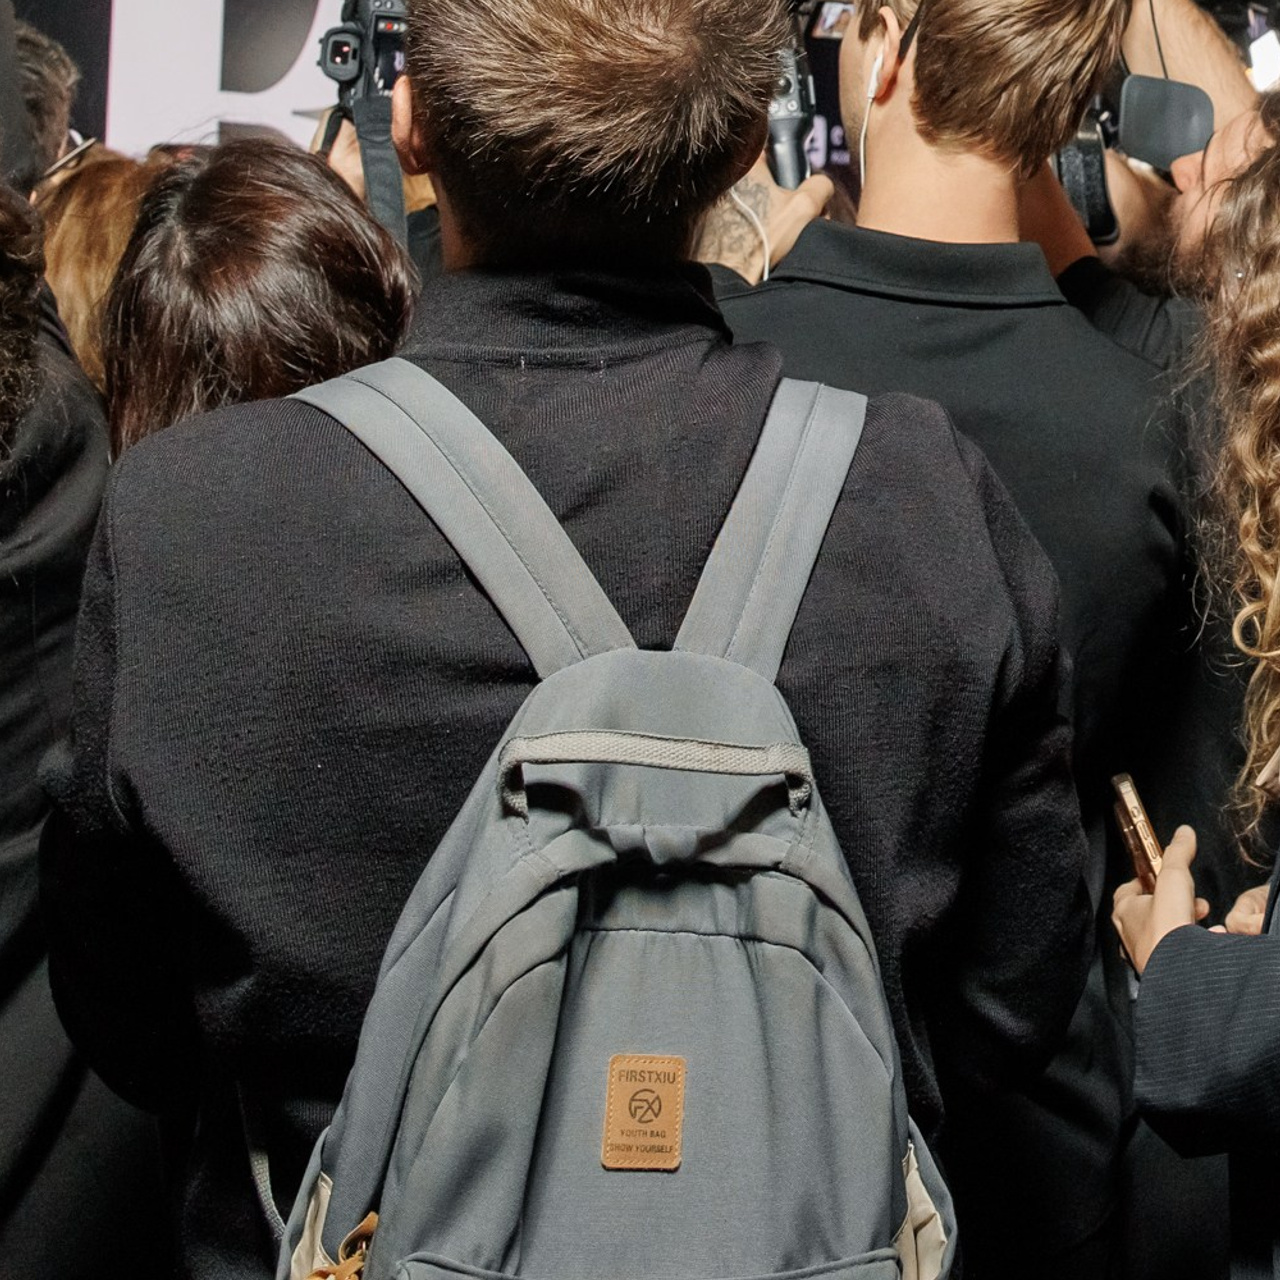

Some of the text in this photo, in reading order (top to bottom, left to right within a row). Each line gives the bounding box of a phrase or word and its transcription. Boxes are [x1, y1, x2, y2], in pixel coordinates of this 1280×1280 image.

[618, 1070, 676, 1083] FIRSTXIU
[621, 1130, 647, 1138] YOUTH
[636, 1146, 673, 1154] YOURSELF
